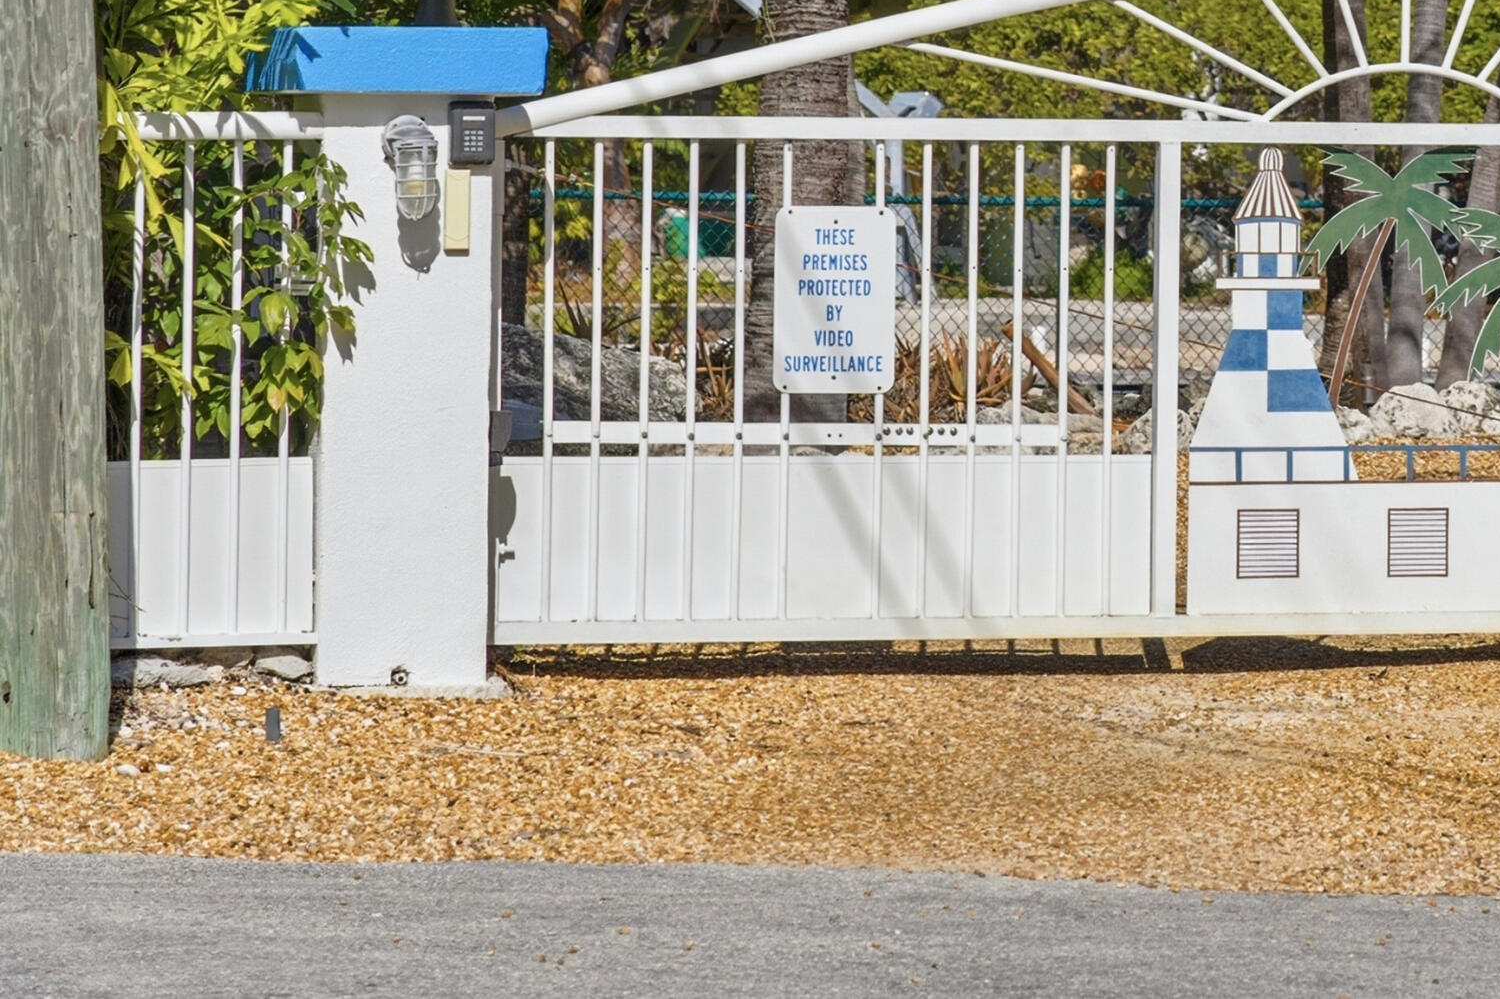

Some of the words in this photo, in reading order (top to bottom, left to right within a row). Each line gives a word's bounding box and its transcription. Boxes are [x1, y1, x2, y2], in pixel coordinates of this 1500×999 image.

[815, 228, 856, 246] THESE
[802, 254, 868, 272] PREMISES
[798, 279, 872, 297] PROTECTED
[826, 304, 843, 322] BY
[814, 329, 854, 347] VIDEO
[784, 355, 884, 373] SURVEILLANCE
